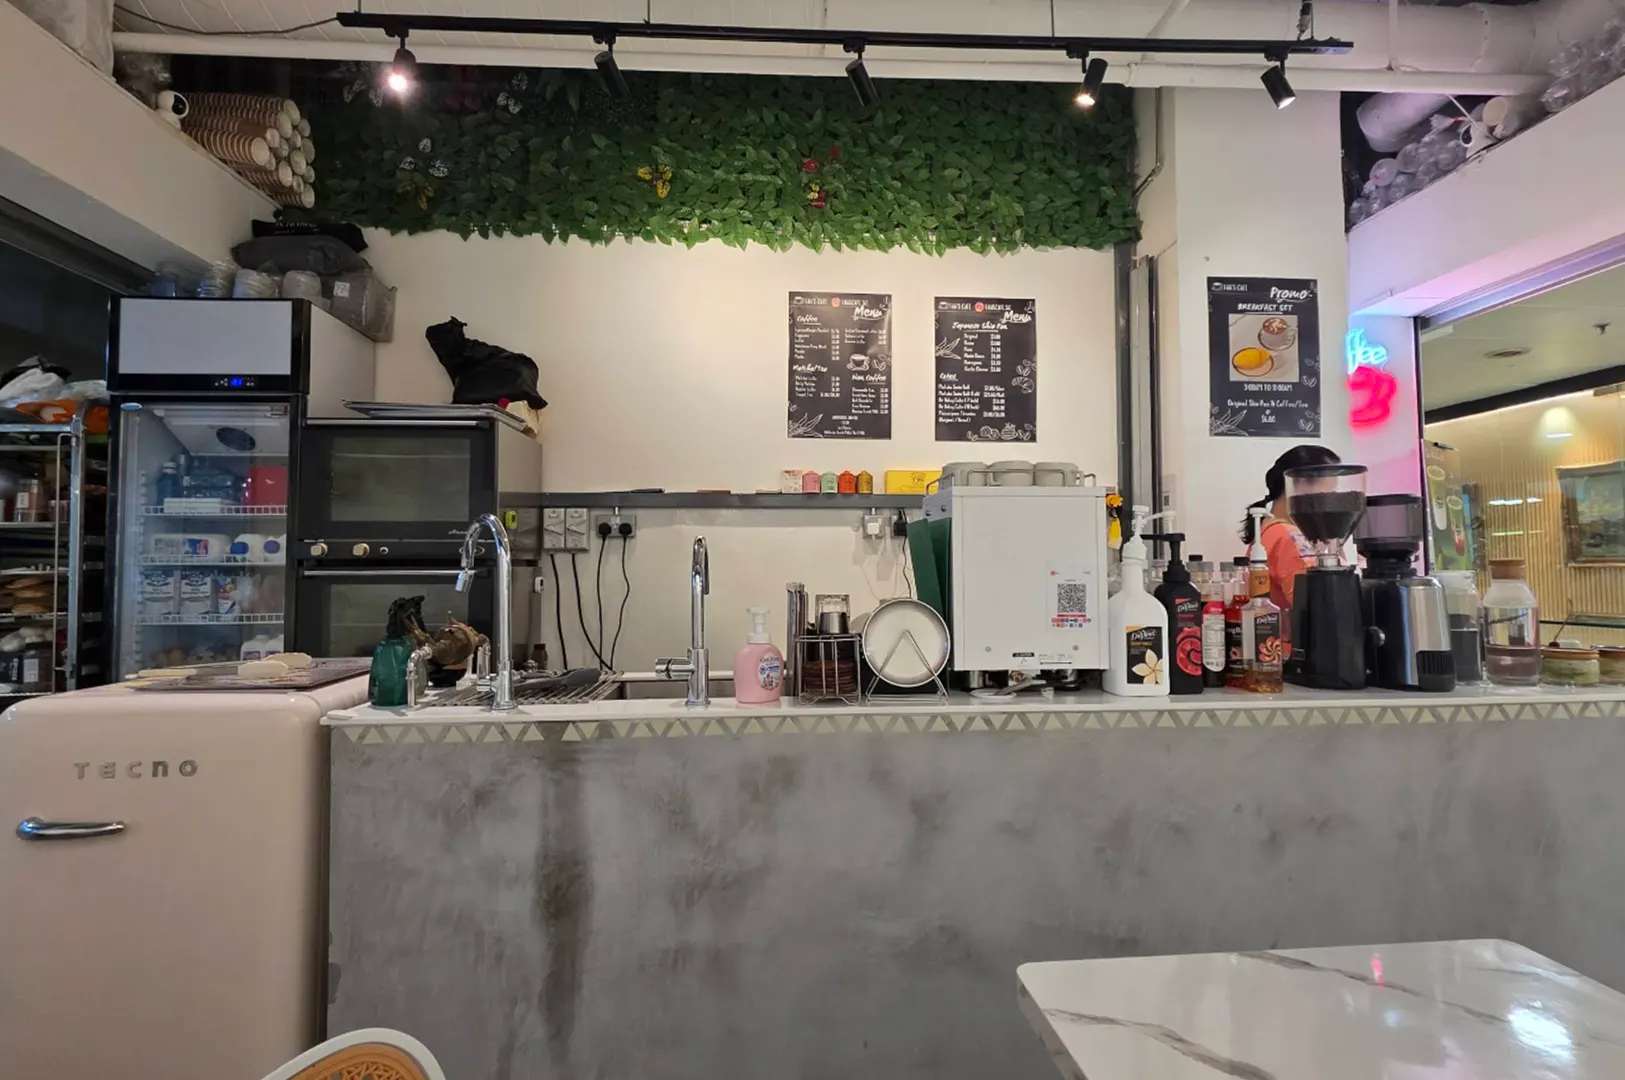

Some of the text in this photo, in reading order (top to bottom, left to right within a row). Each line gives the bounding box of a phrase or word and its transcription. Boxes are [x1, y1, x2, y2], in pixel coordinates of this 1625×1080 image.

[1269, 286, 1307, 300] Promo
[853, 305, 883, 318] Menu
[1237, 303, 1294, 312] BREAKFAST SET
[1003, 309, 1032, 322] Menu
